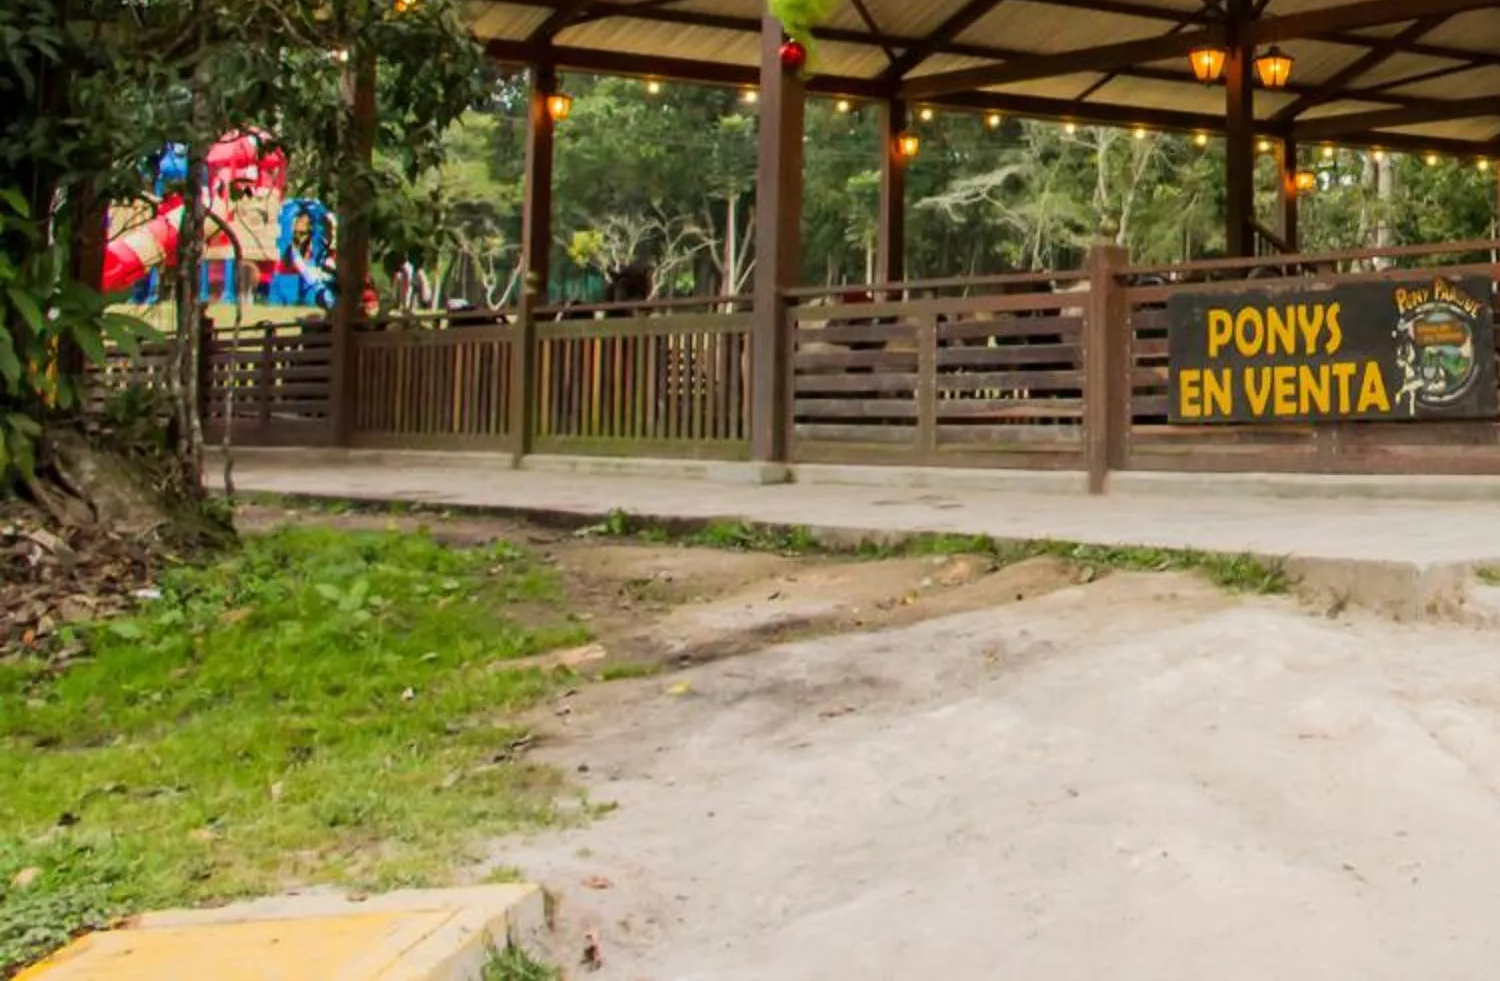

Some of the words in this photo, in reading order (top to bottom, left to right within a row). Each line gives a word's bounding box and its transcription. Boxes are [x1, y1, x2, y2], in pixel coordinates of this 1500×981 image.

[1207, 302, 1342, 358] PONYS
[1179, 368, 1233, 417] EN
[1244, 360, 1391, 416] VENTA
